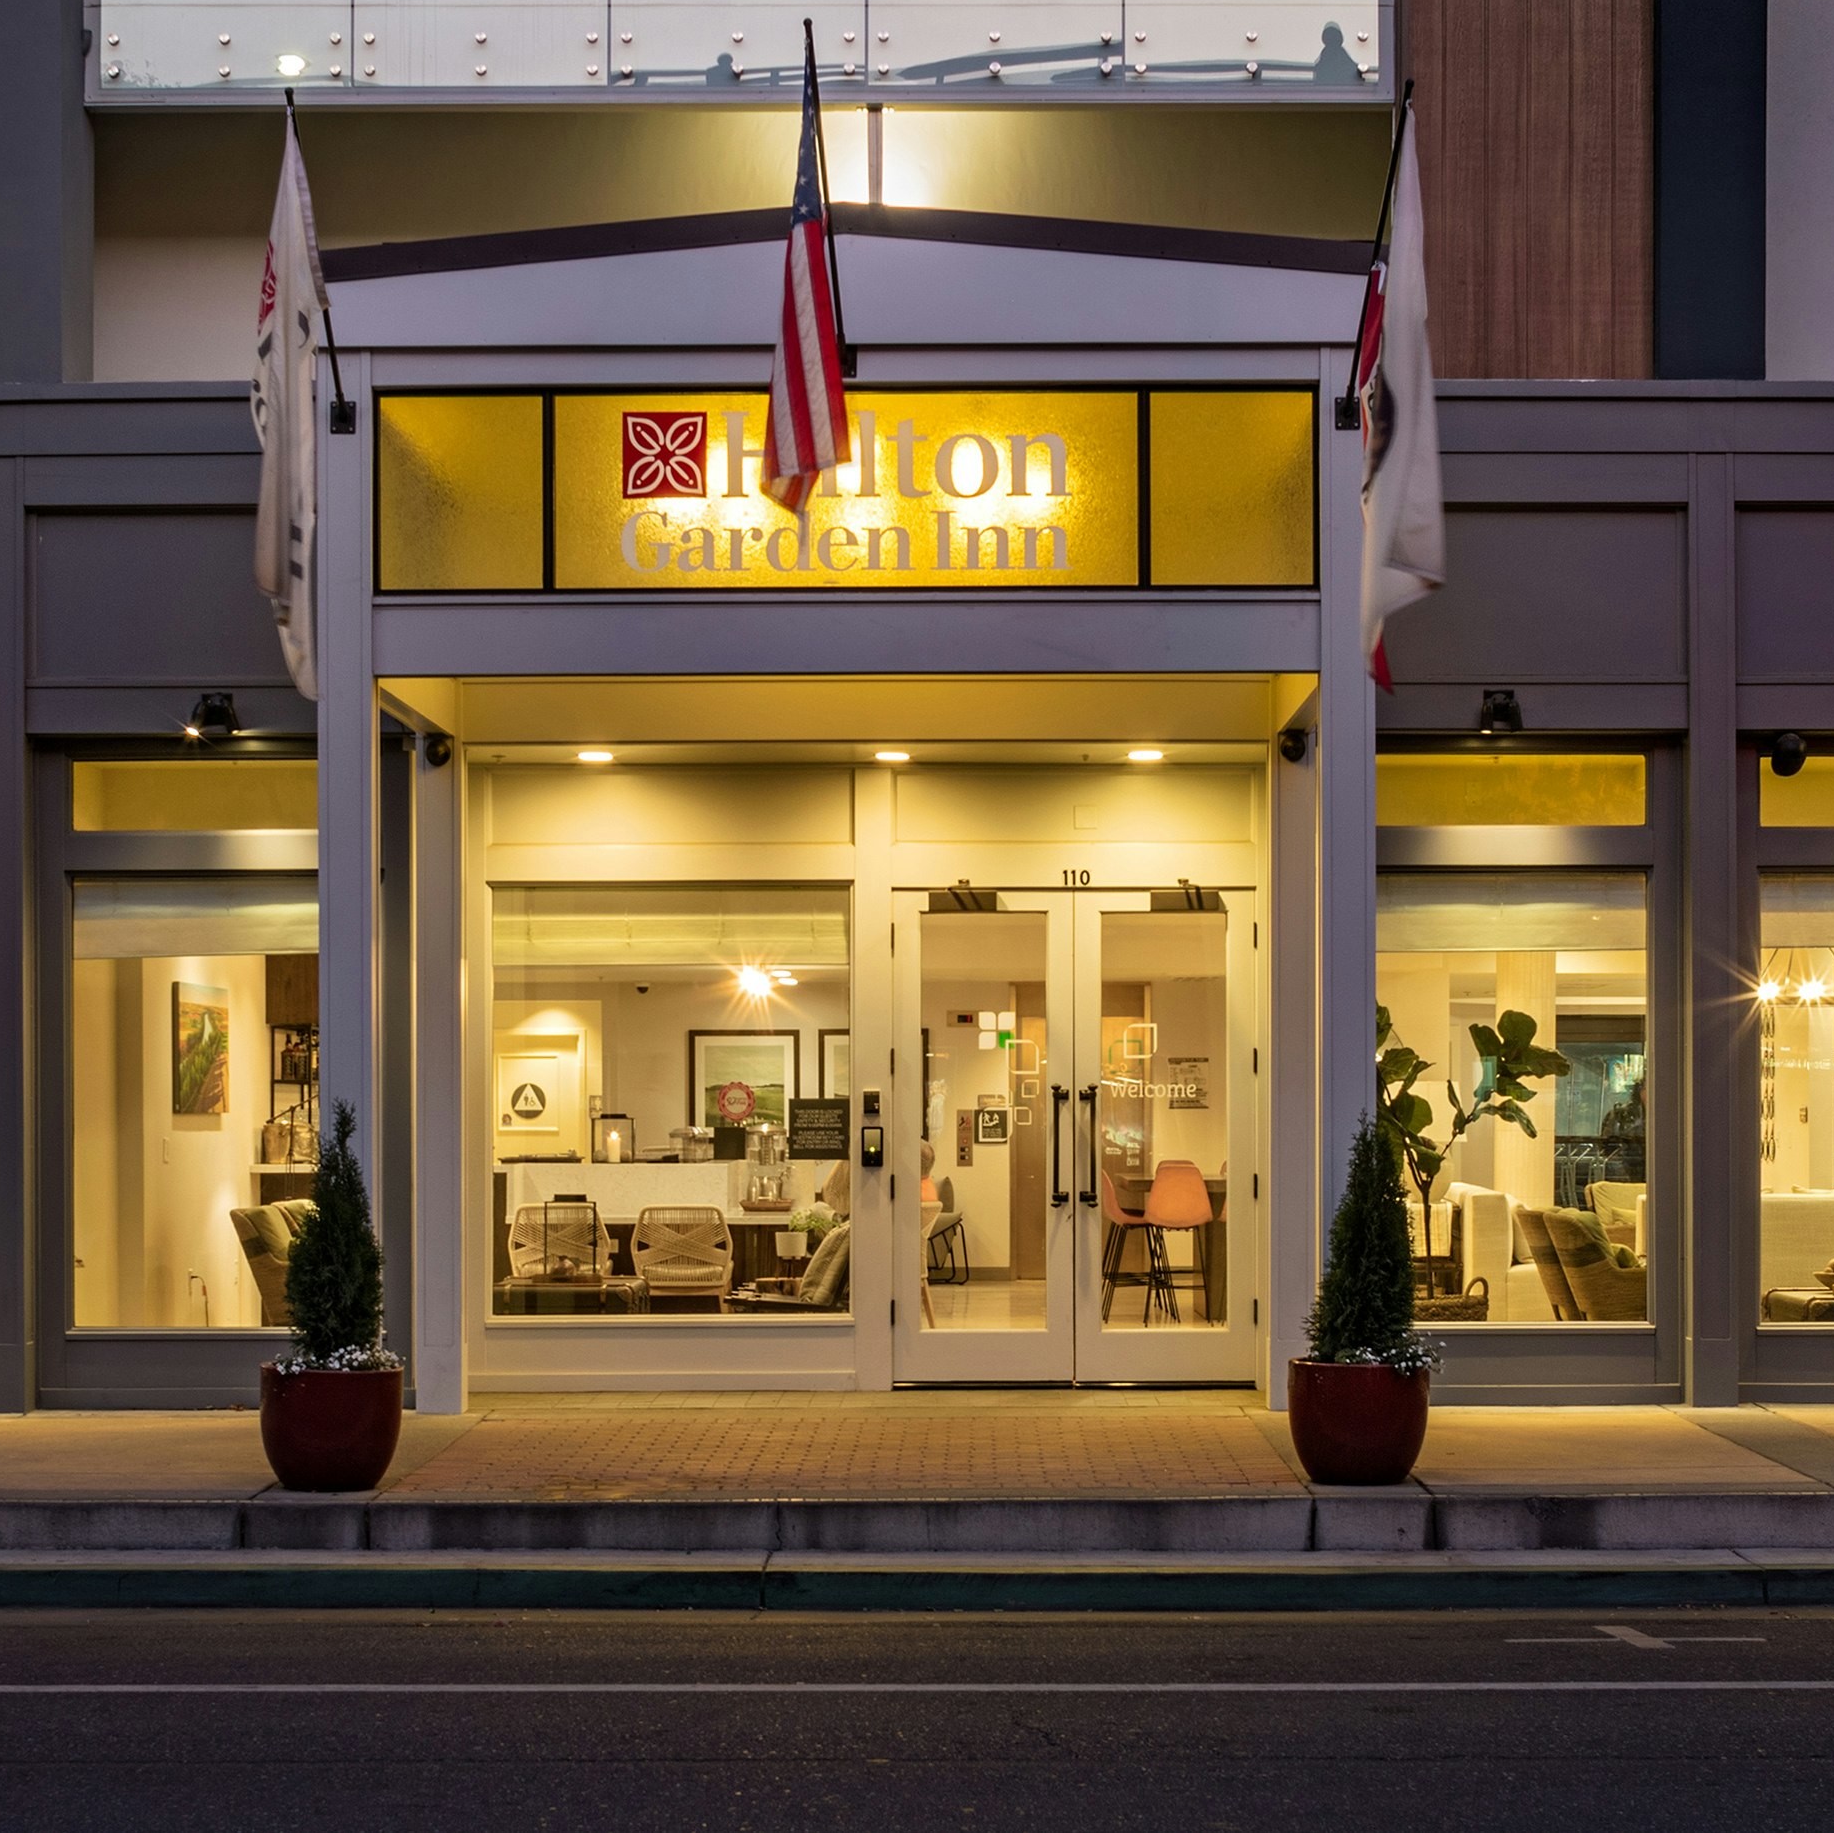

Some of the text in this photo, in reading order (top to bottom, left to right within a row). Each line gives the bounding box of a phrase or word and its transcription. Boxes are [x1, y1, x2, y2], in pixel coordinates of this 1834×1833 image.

[621, 510, 1071, 573] Garden Inn
[1063, 870, 1090, 885] 110
[1110, 1080, 1197, 1098] Welcome
